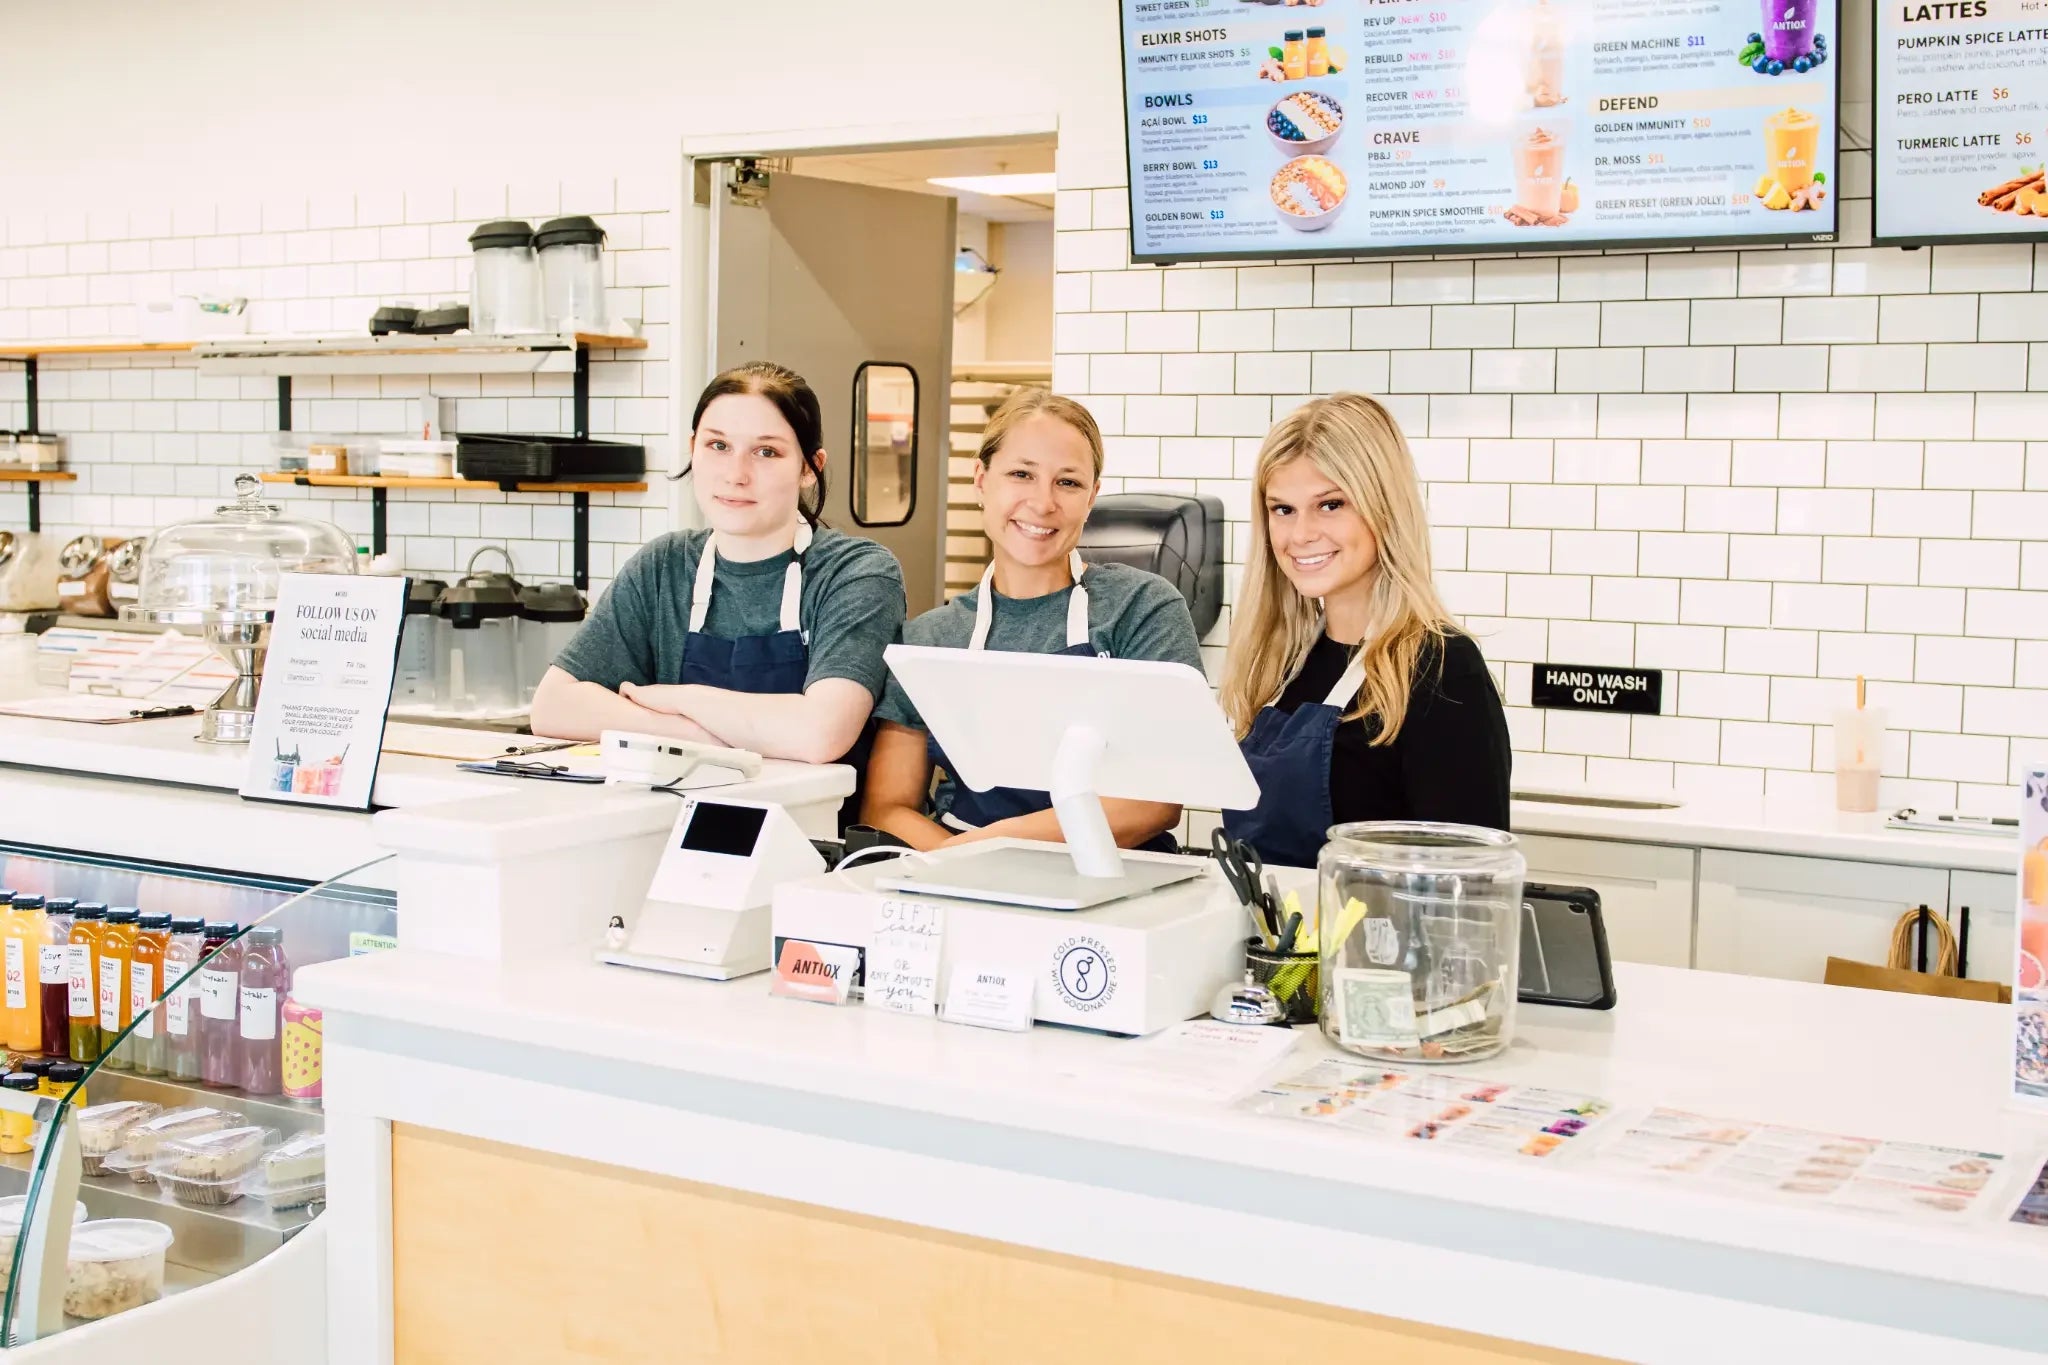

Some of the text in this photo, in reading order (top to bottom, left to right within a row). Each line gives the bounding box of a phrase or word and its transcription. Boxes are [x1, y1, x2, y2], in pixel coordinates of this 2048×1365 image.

[1136, 3, 1161, 12] SWEET
[1164, 1, 1190, 10] GREEN
[1903, 0, 2039, 22] LATTES Hot
[1364, 17, 1380, 27] REV
[1383, 16, 1395, 25] UP
[1429, 11, 1447, 23] $10
[1773, 19, 1807, 30] ANTIOX
[1142, 29, 1227, 46] ELIXIR SHOTS
[1594, 36, 1705, 53] GREEN MACHINE $11
[1897, 28, 2048, 49] PUMPKIN SPICE LATTE
[1138, 54, 1179, 64] IMMUNITY
[1181, 52, 1206, 61] ELIXIR
[1208, 50, 1234, 58] SHOTS
[1365, 54, 1403, 64] REBUILD
[1145, 94, 1193, 108] BOWLS
[1366, 91, 1408, 102] RECOVER
[1897, 87, 2009, 105] PERO LATTE $6
[1599, 96, 1658, 112] DEFEND
[1162, 116, 1186, 125] BOWL
[1192, 114, 1208, 125] $13
[1595, 122, 1633, 133] GOLDEN
[1636, 120, 1686, 130] IMMUNITY
[1373, 131, 1420, 144] CRAVE
[1897, 132, 2032, 150] TURMERIC LATTE $6
[1368, 152, 1391, 160] PB&J
[1595, 157, 1611, 166] DR.
[1613, 155, 1641, 165] MOSS
[1143, 160, 1218, 172] BERRY BOWL $13
[1369, 181, 1406, 191] ALMOND
[1409, 181, 1426, 189] JOY
[1595, 200, 1626, 210] GREEN
[1629, 198, 1657, 208] RESET
[1660, 196, 1692, 208] (GREEN
[1695, 195, 1726, 206] JOLLY)
[1145, 210, 1224, 222] GOLDEN BOWL $13
[1370, 208, 1410, 219] PUMPKIN
[1413, 208, 1437, 217] SPICE
[1440, 206, 1484, 216] SMOOTHIE
[297, 605, 378, 621] FOLLOW US ON
[301, 624, 368, 642] social media
[1546, 671, 1647, 691] HAND WASH
[1573, 688, 1618, 704] ONLY
[882, 901, 942, 926] GIFT
[363, 939, 397, 949] ATTENTION
[7, 970, 21, 982] 02
[792, 959, 840, 980] ANTIOX
[72, 977, 86, 990] 01
[977, 974, 1006, 986] ANTIOX
[102, 989, 113, 1003] 01
[1051, 969, 1118, 1012] WITH GOODNATURE
[133, 995, 145, 1009] 01
[168, 994, 181, 1008] 01
